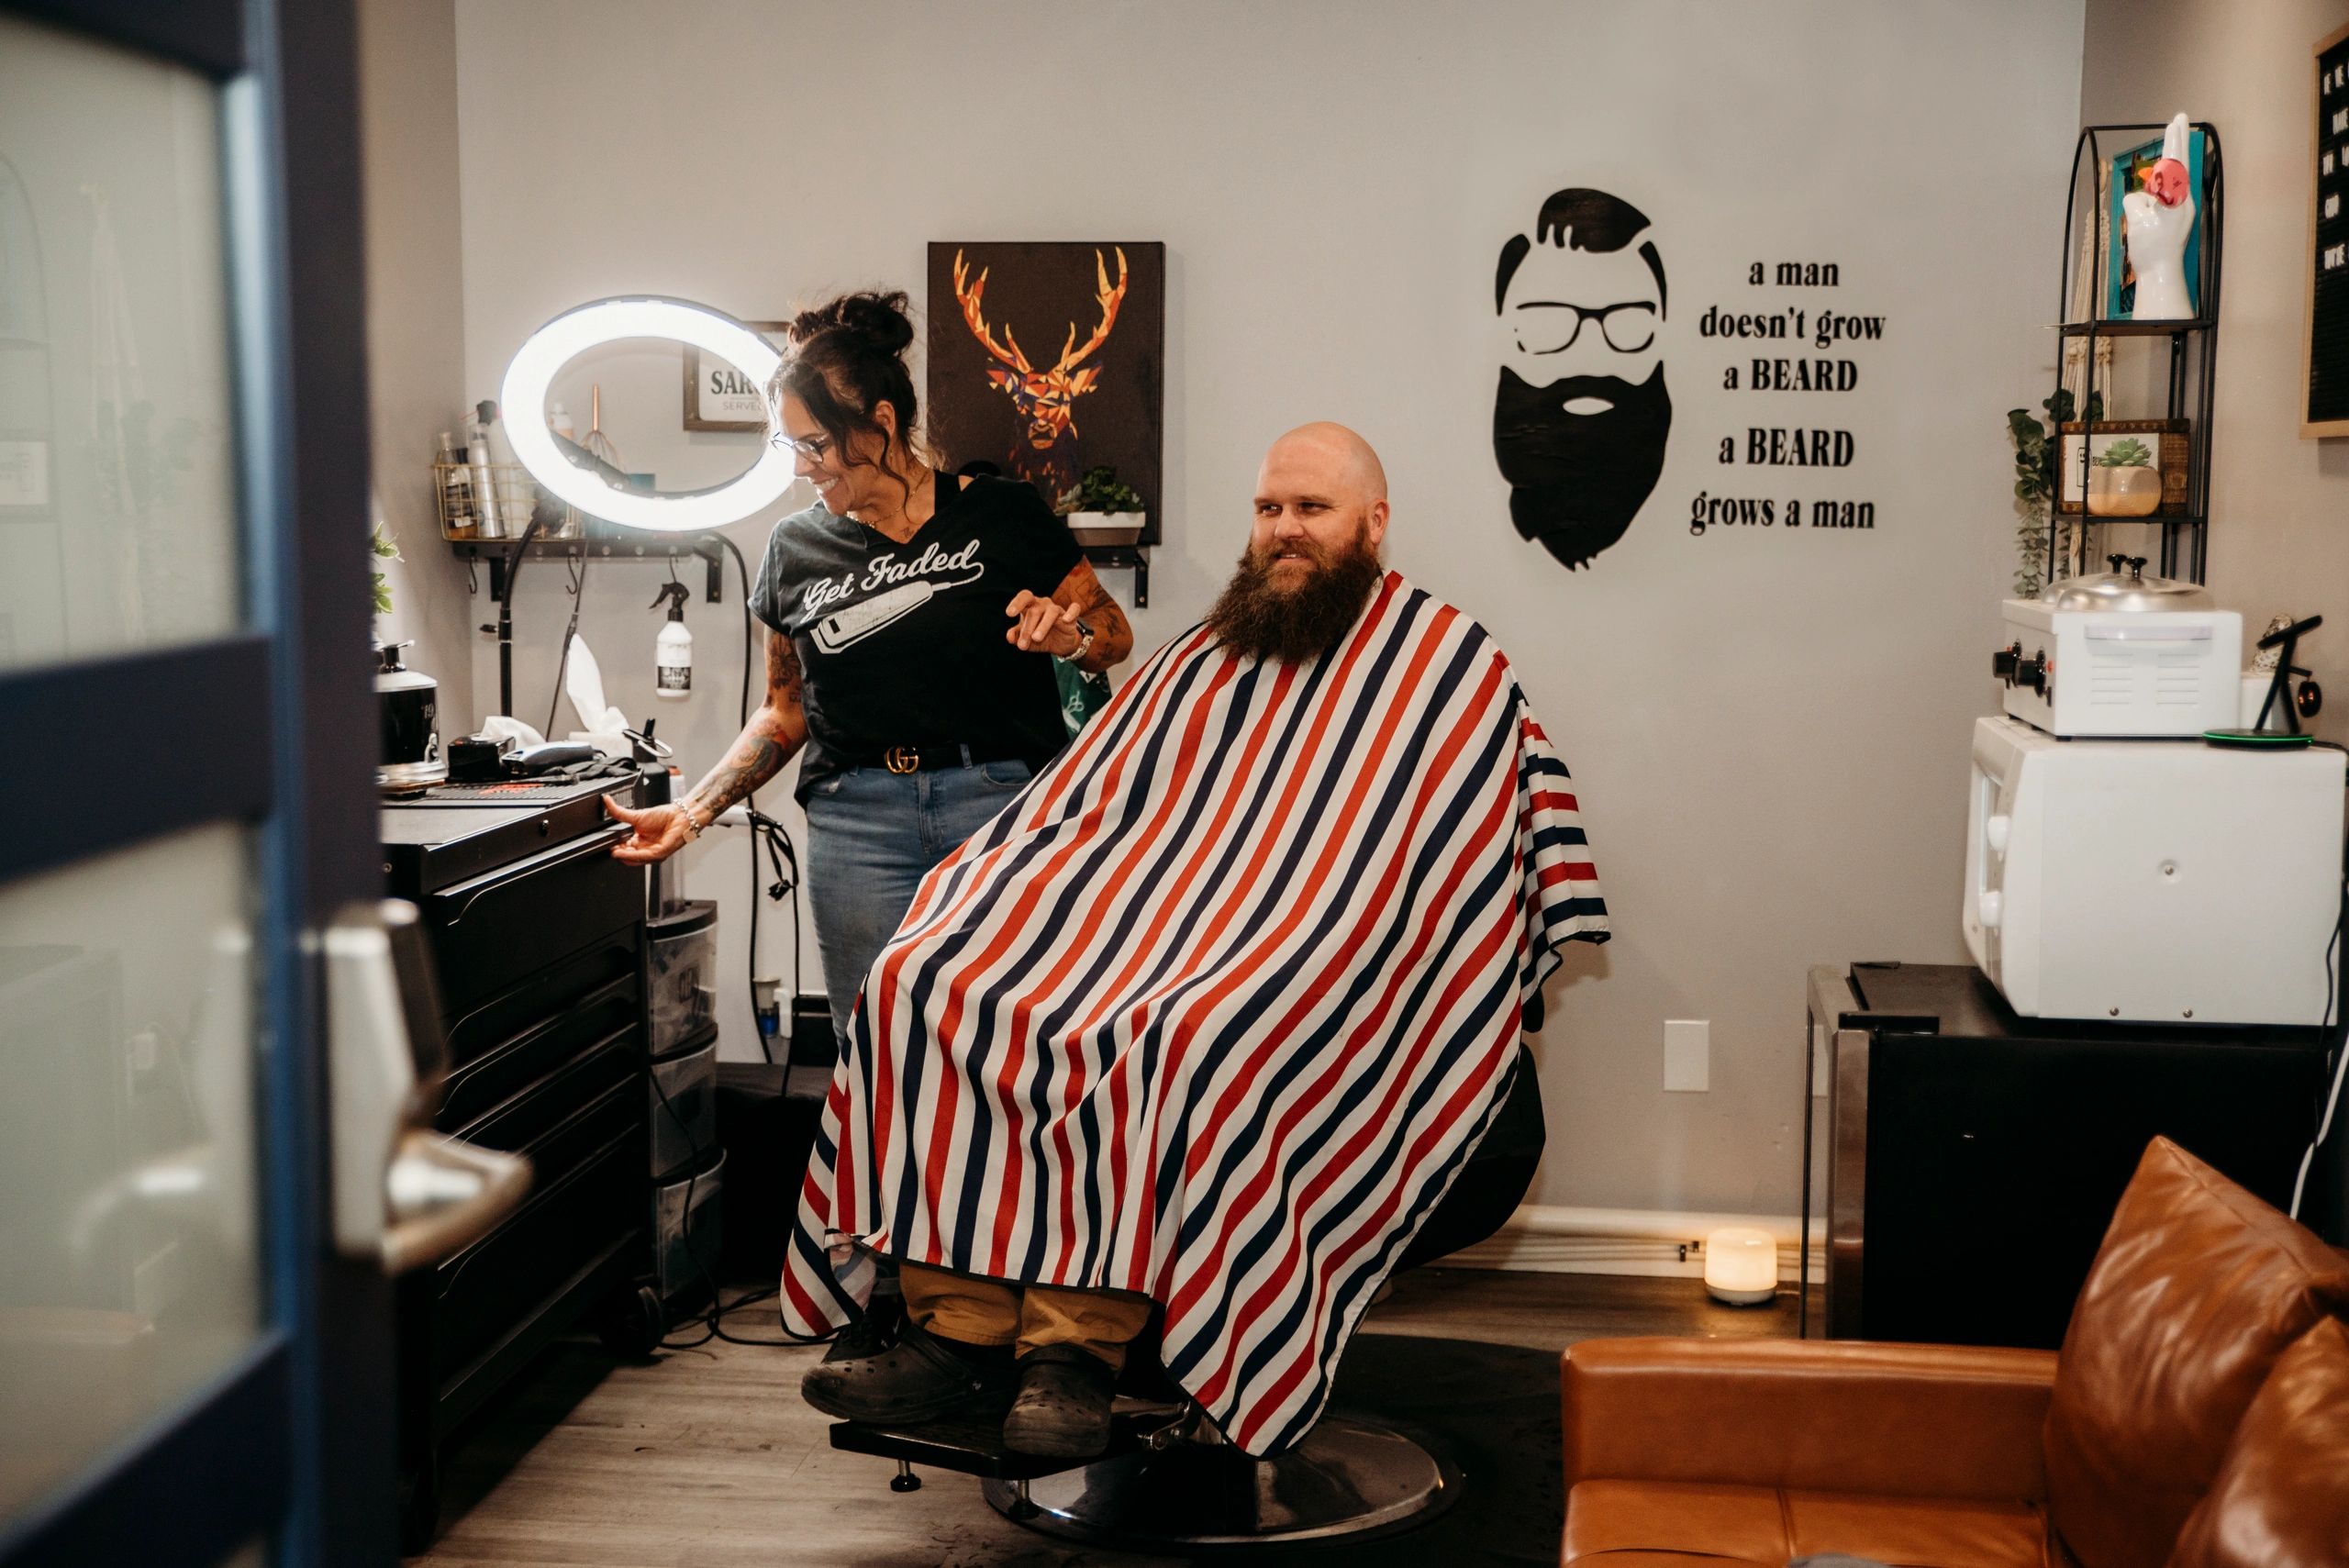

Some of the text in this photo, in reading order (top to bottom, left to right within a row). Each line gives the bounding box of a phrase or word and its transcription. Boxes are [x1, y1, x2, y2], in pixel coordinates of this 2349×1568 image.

[1748, 261, 1840, 287] a man
[1699, 305, 1887, 350] doesn't grow
[710, 370, 762, 395] SAR
[1722, 358, 1858, 392] a BEARD
[1718, 428, 1855, 468] a BEARD
[1689, 490, 1876, 537] grows a man
[800, 539, 985, 624] Get Faded
